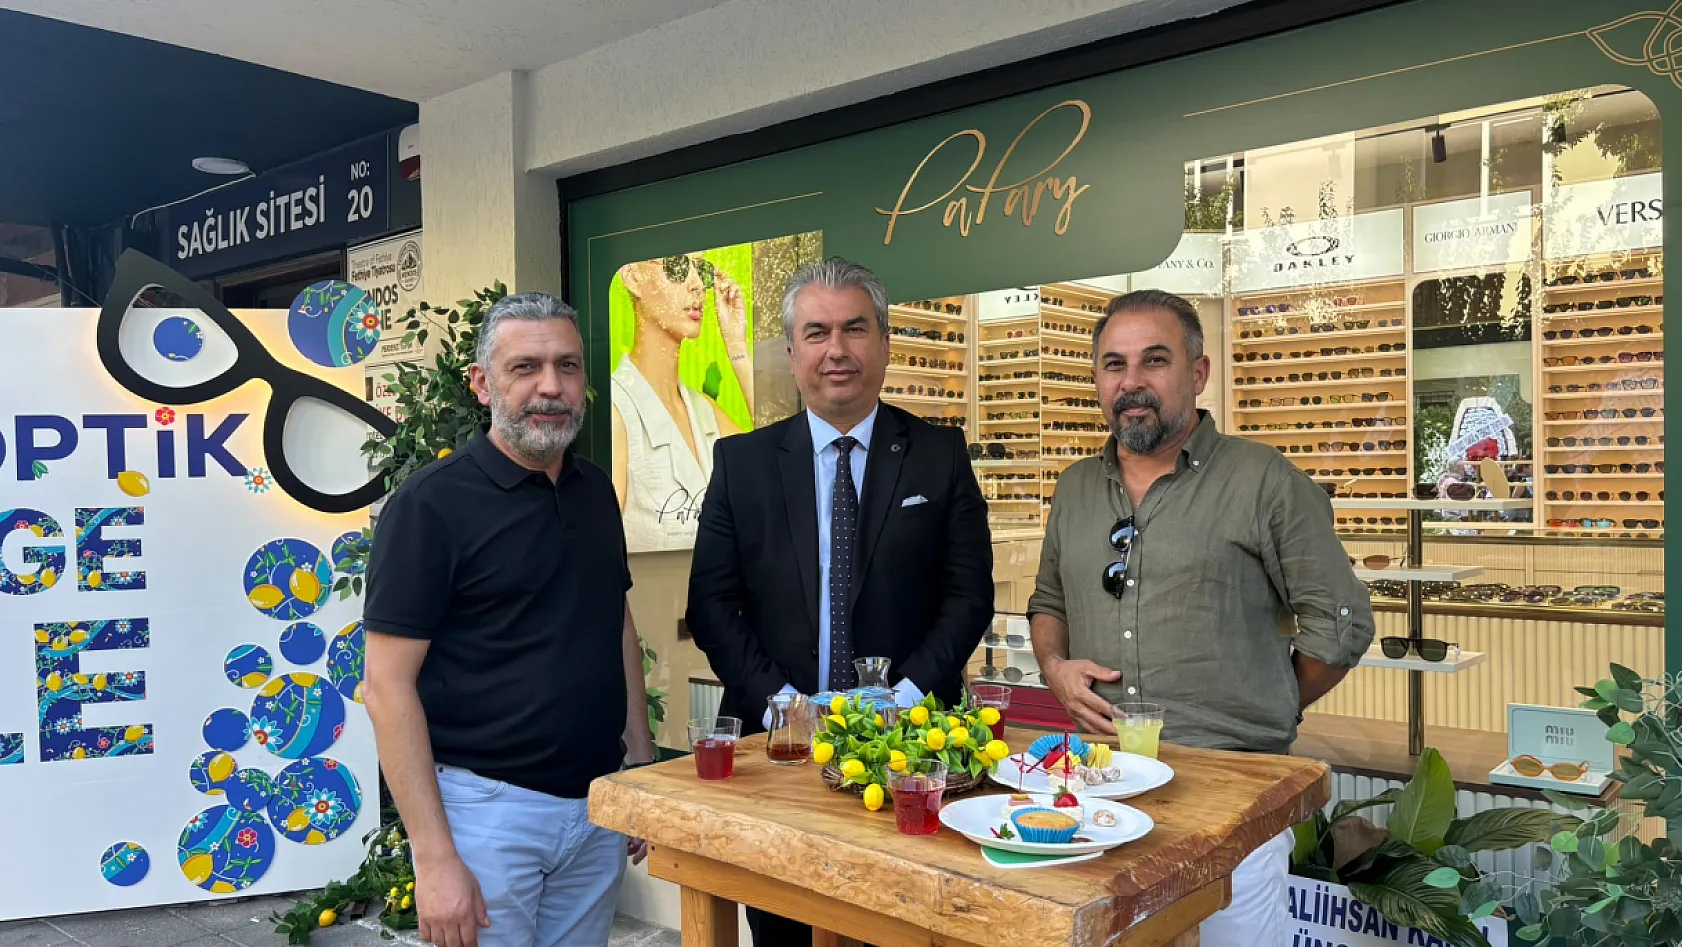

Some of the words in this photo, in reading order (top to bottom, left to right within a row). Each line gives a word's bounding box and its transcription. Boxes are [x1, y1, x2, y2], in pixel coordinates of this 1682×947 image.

[350, 160, 370, 181] NO:
[347, 185, 373, 222] 20
[177, 206, 250, 259] SAĞLIK
[255, 175, 325, 240] SİTESİ
[1424, 228, 1470, 244] GIORGIO
[1474, 222, 1518, 238] ARMANI
[1273, 254, 1355, 272] OAKLEY
